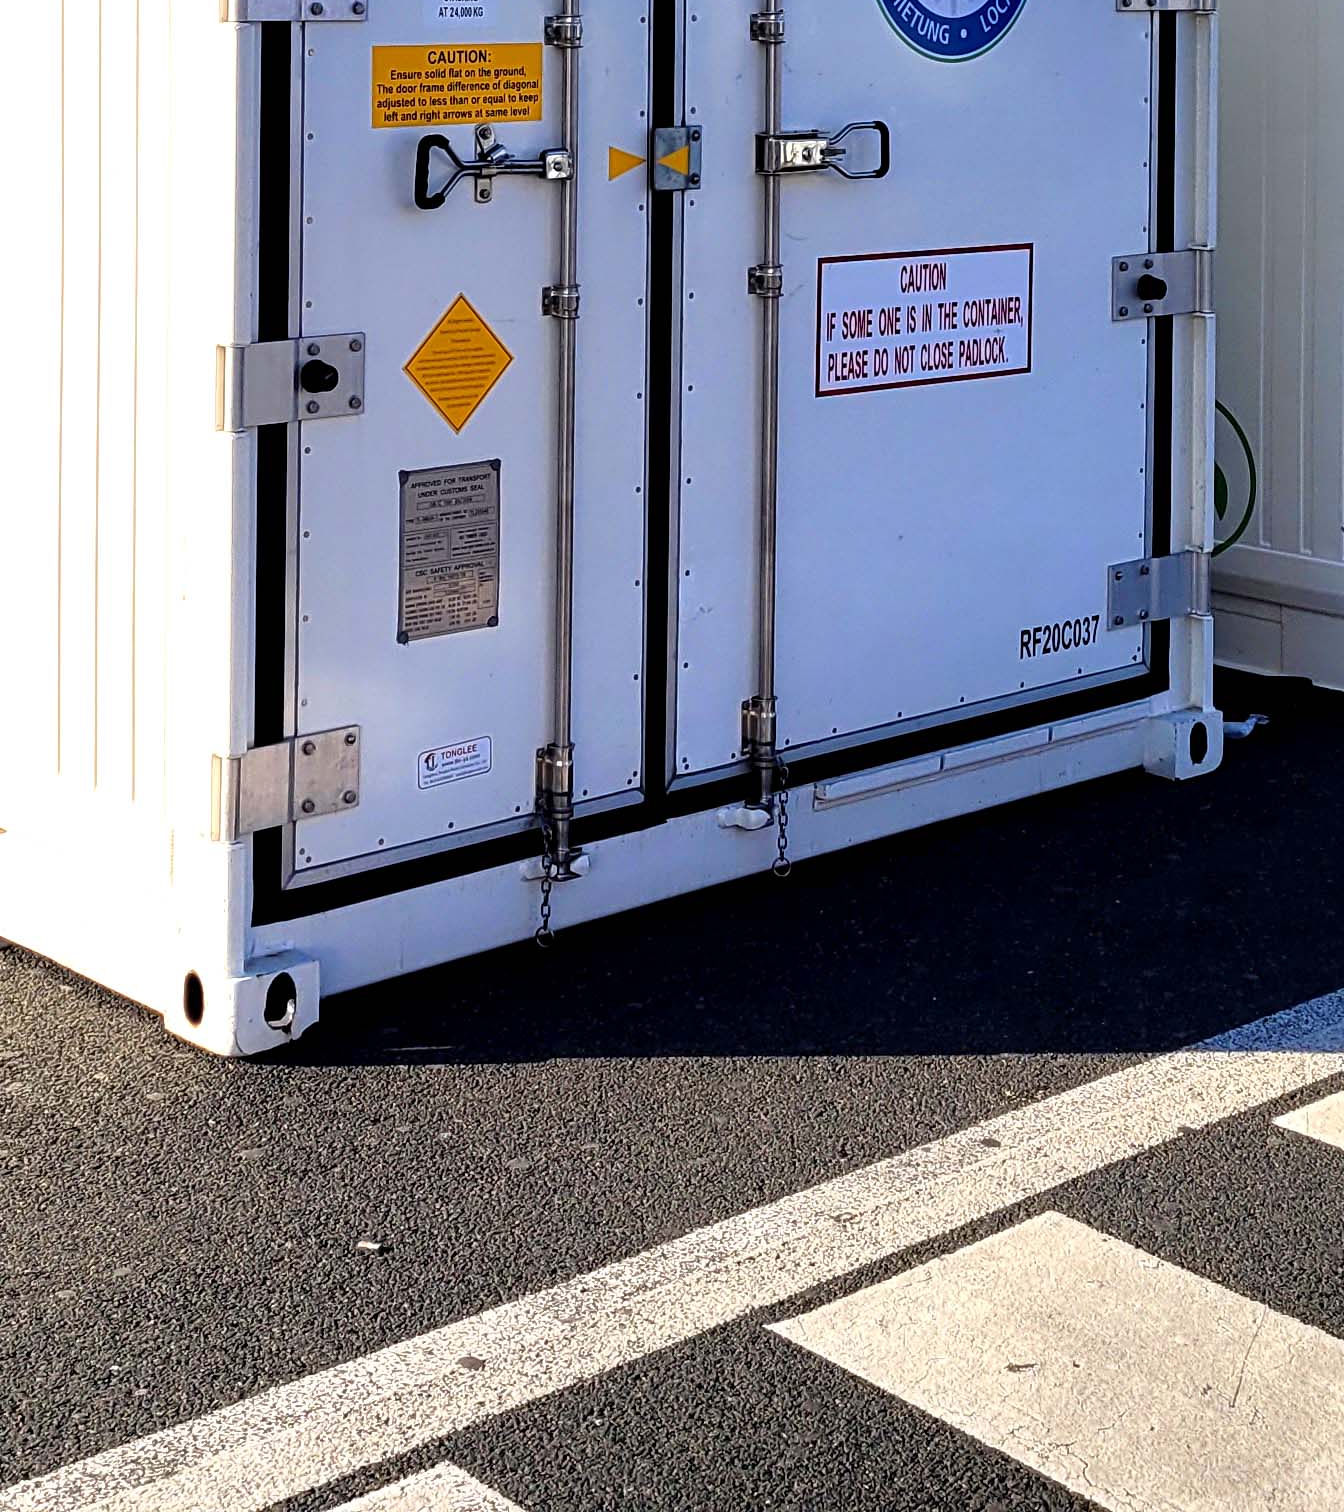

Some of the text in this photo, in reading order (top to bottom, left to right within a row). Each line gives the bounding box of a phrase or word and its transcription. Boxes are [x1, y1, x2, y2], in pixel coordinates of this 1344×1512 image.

[438, 7, 448, 17] AT
[427, 49, 492, 65] CAUTION:
[390, 69, 422, 80] Ensure
[424, 68, 446, 79] solid
[448, 68, 463, 78] flat
[478, 67, 492, 77] the
[493, 66, 526, 78] ground,
[377, 79, 539, 94] The door frame difference of diagonal
[377, 92, 539, 110] adjusted to less than or equal to keep
[383, 106, 530, 123] left and right arrows at same level
[900, 262, 947, 293] CAUTION
[826, 296, 1023, 341] IF SOME ONE IS IN THE CONTAINER,
[828, 336, 1009, 383] PLEASE DO NOT CLOSE PADLOCK.
[1020, 615, 1100, 659] RF20C037
[441, 744, 478, 760] TONGLEE
